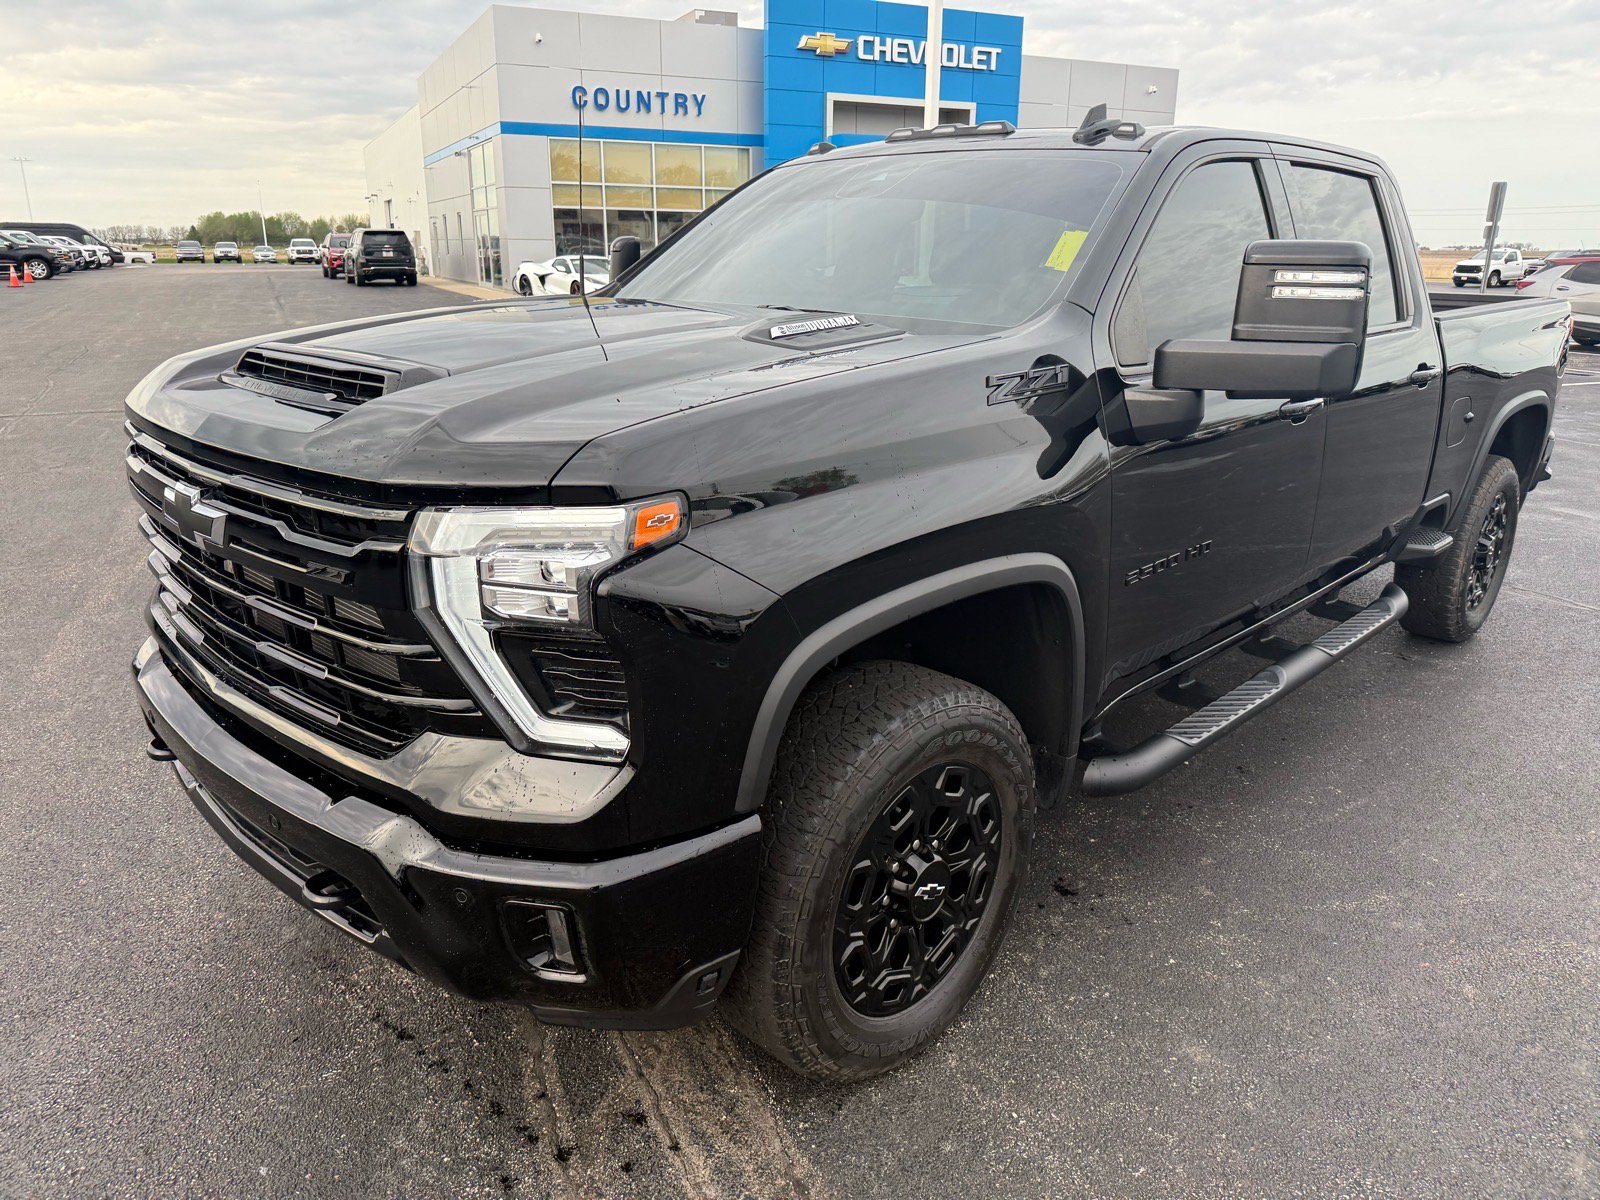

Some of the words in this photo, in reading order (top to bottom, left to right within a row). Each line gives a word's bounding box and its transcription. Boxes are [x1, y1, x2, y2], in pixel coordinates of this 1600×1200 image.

[857, 34, 1002, 71] CHEVOLET
[571, 85, 707, 117] COUNTRY
[807, 315, 860, 331] DURAMAX
[985, 363, 1069, 406] Z71
[1185, 539, 1213, 561] HD
